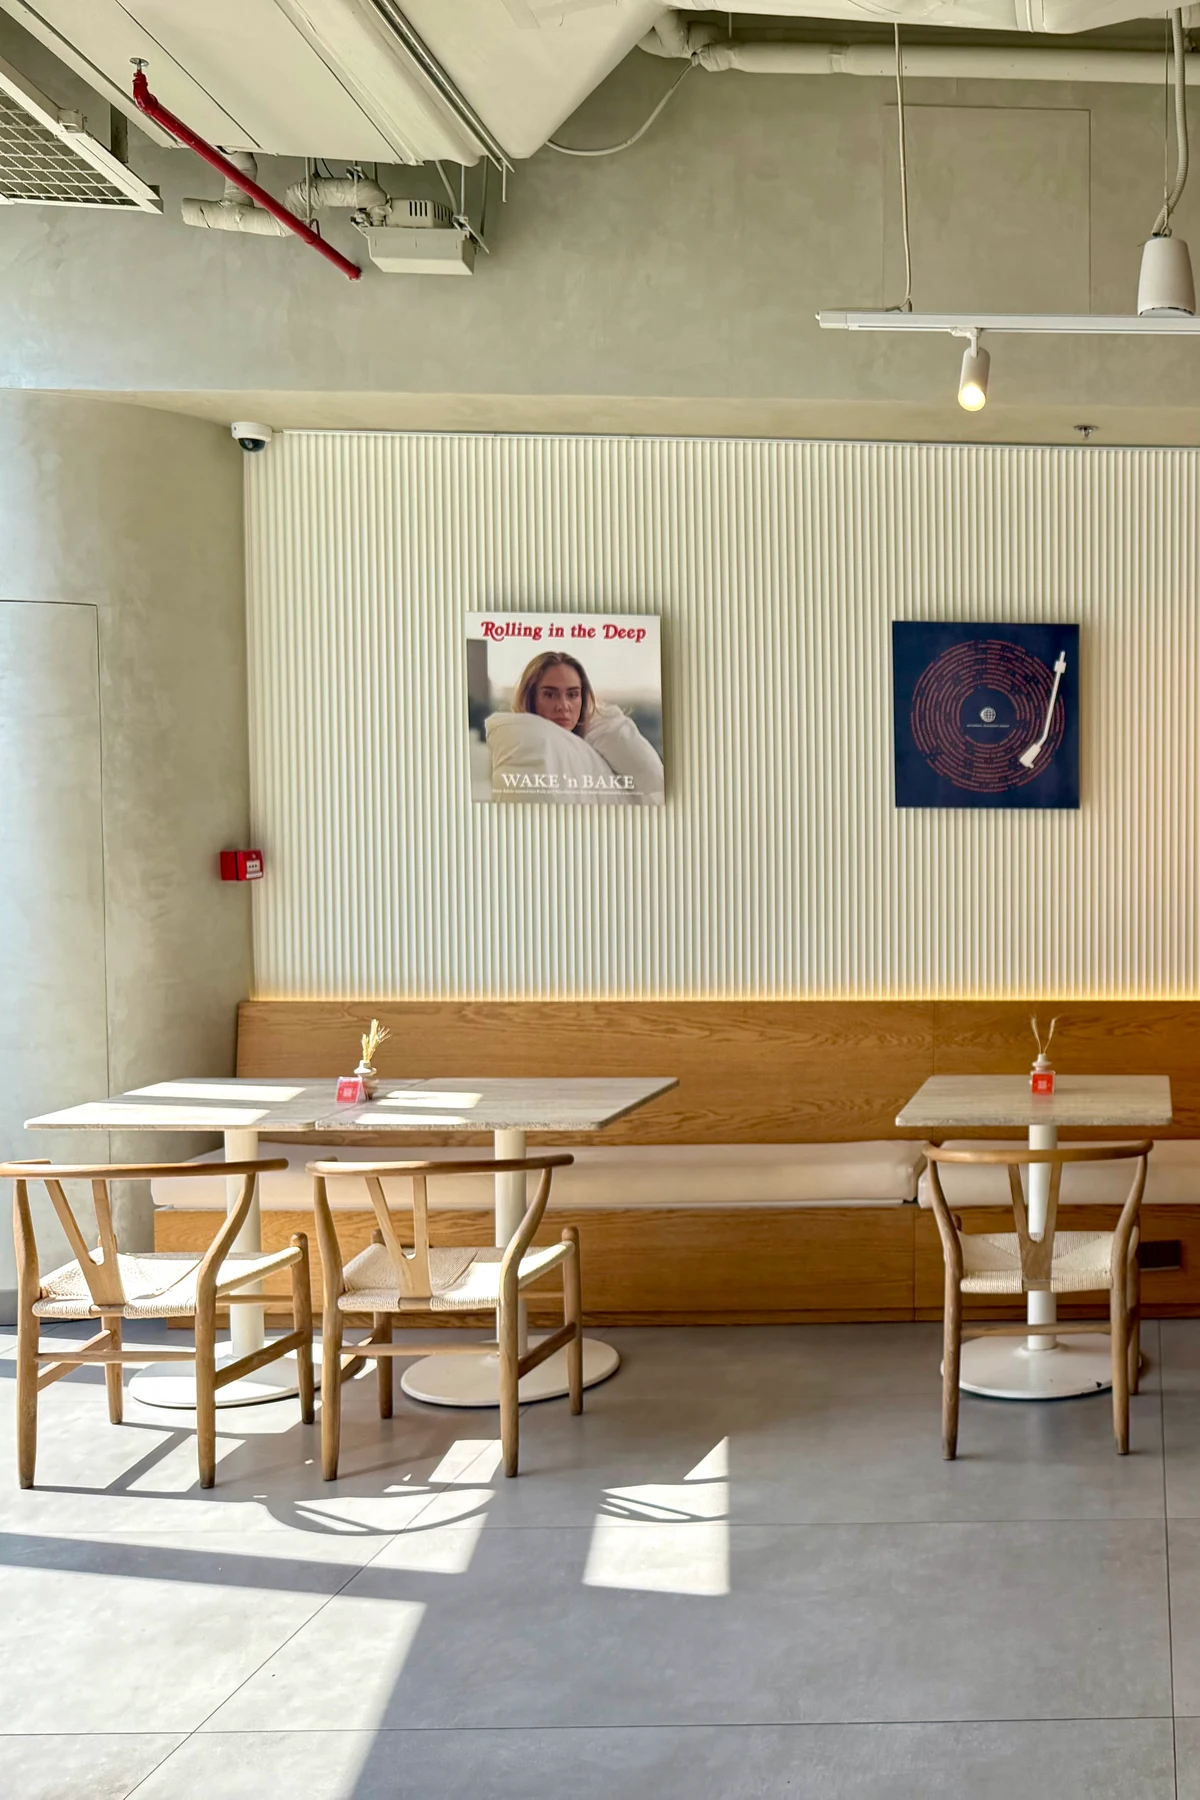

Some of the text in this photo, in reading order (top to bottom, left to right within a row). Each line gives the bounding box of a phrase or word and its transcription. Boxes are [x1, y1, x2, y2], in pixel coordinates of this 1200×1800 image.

[481, 621, 647, 643] Rolling in the Deep
[501, 773, 560, 788] WAKE
[583, 775, 635, 789] BAKE
